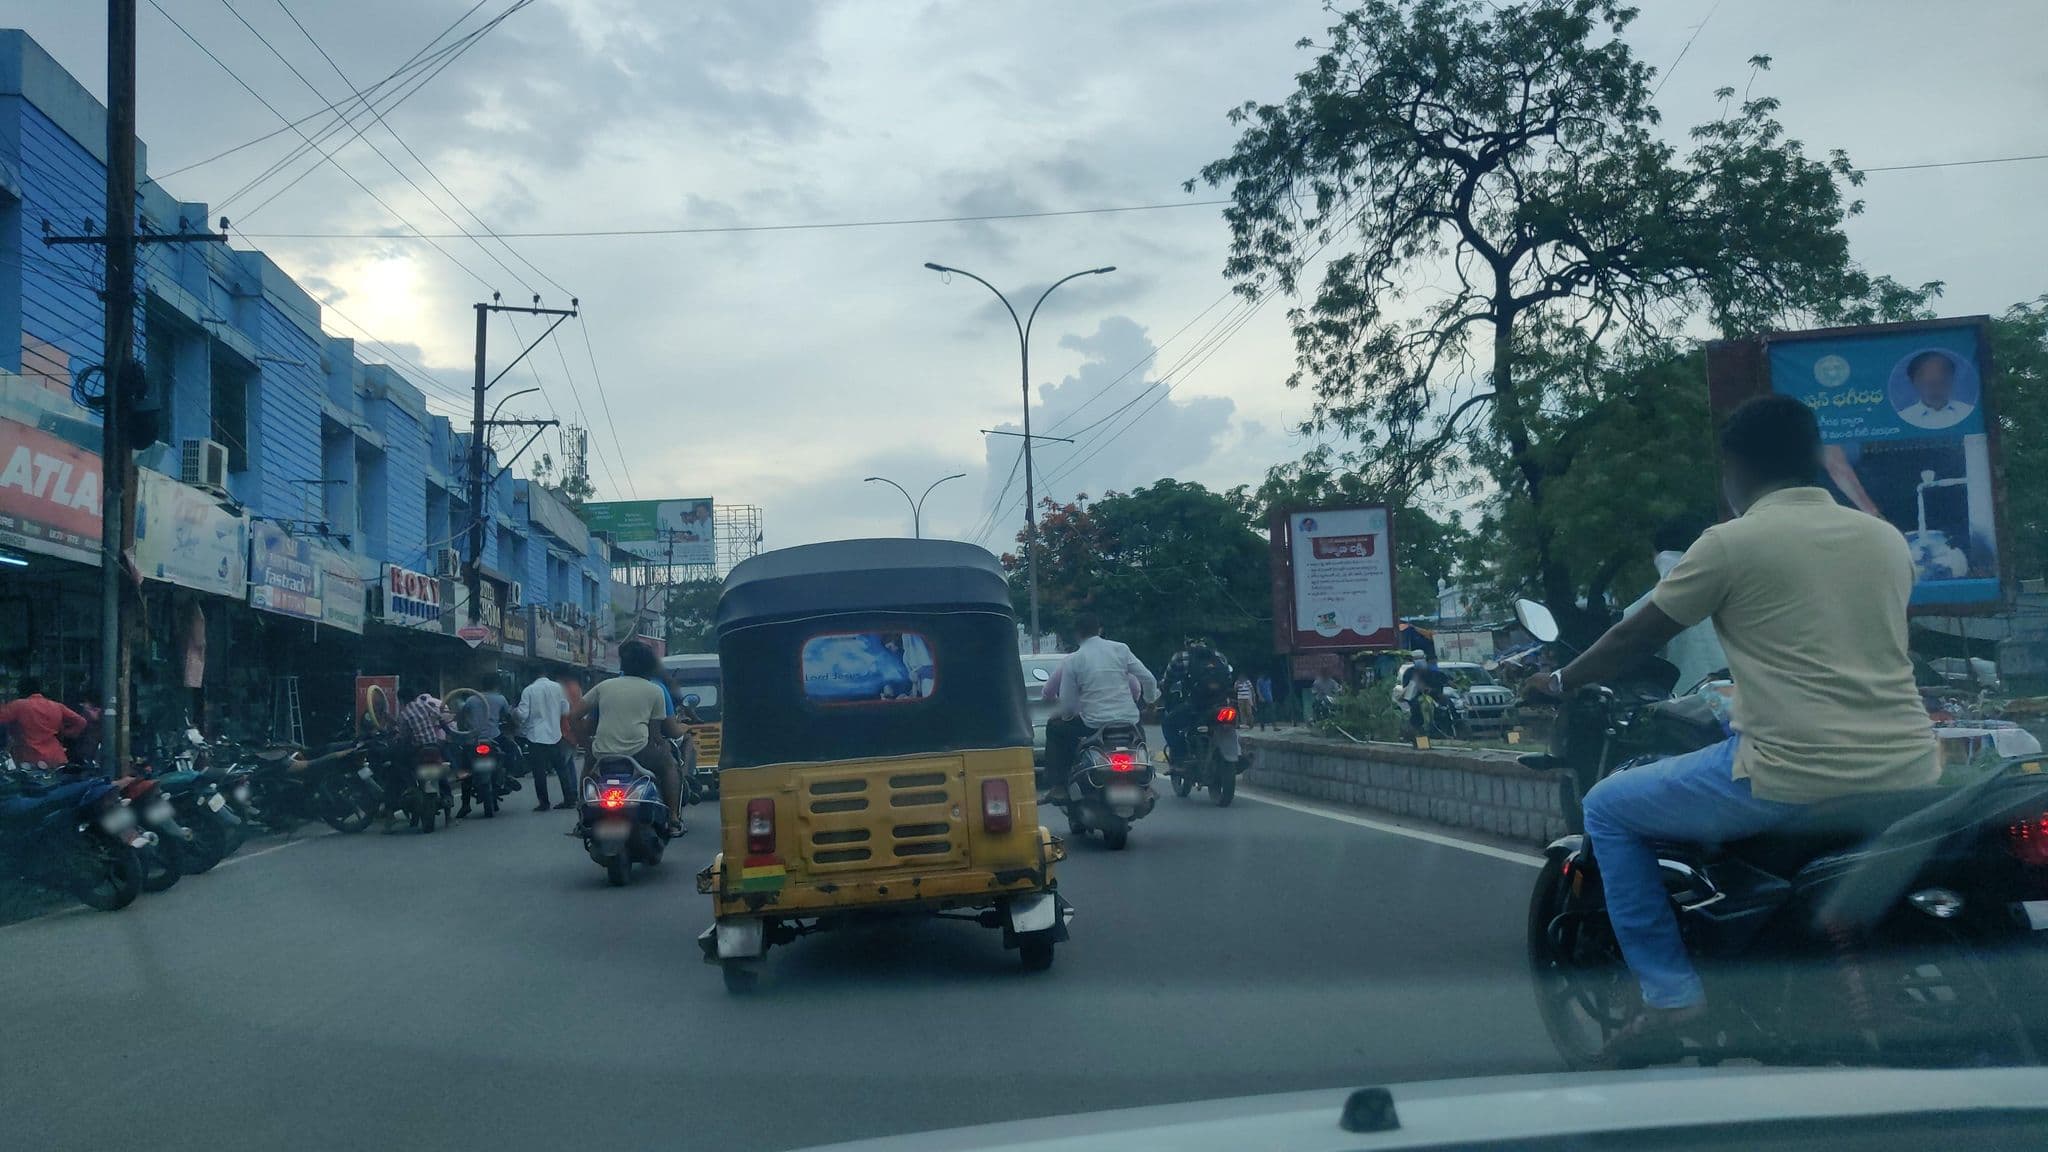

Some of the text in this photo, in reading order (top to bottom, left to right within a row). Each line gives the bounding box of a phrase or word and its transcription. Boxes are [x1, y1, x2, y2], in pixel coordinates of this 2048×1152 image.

[0, 445, 103, 518] ATLA
[264, 566, 306, 594] fastrack
[391, 566, 440, 604] ROXY
